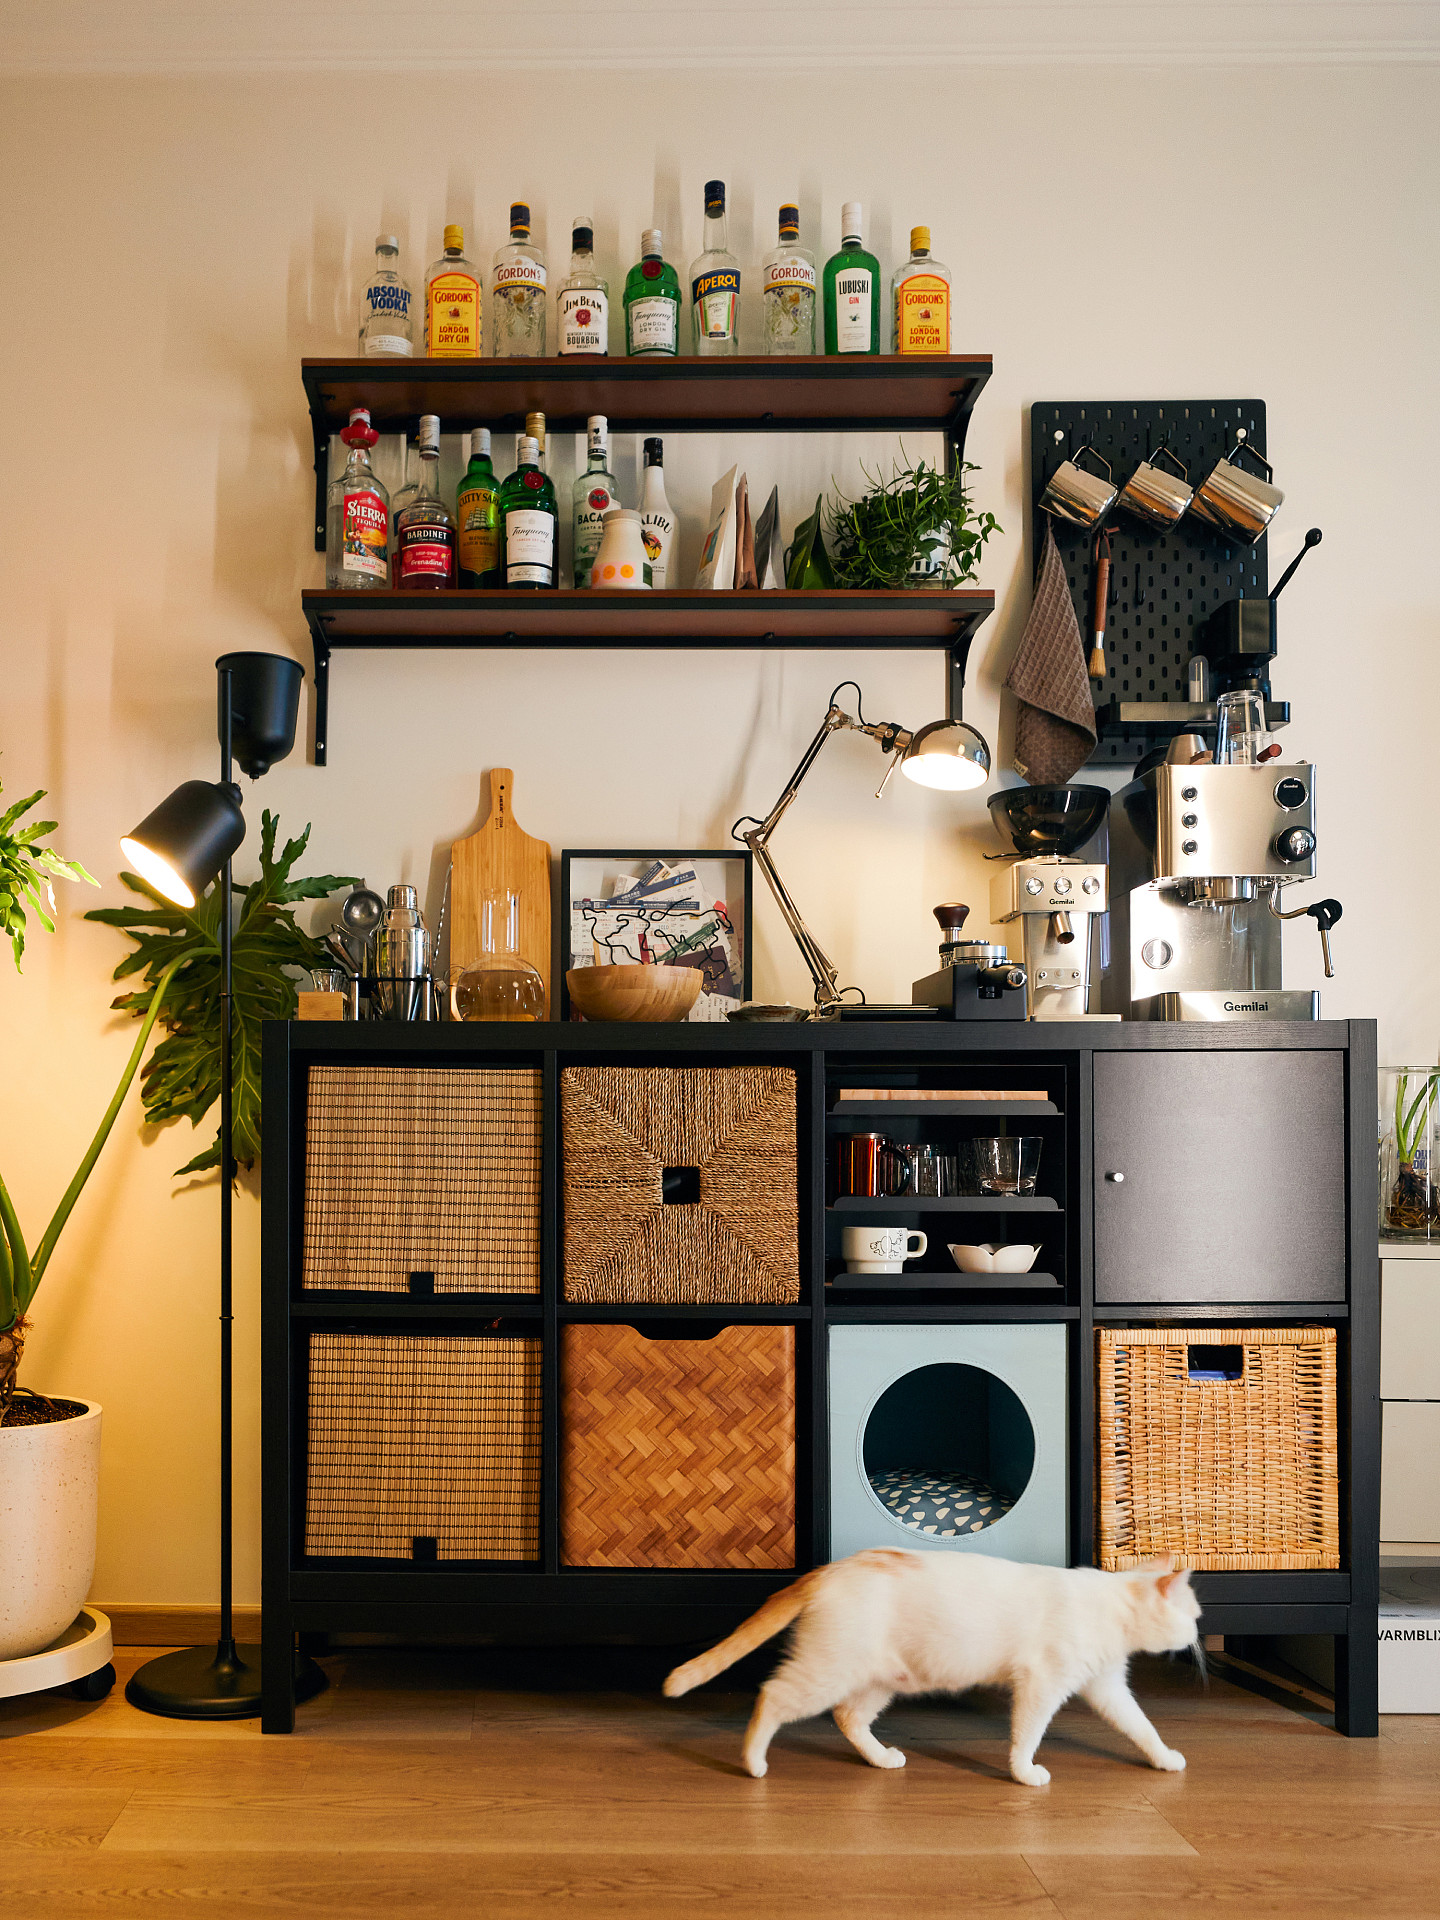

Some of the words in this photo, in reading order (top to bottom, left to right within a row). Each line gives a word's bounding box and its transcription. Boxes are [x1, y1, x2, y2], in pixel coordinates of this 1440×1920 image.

[497, 267, 541, 281] GORDON'S
[771, 267, 814, 281] GORDON'S
[696, 274, 738, 298] APEROL
[839, 280, 869, 295] LUBUSKI
[366, 286, 412, 304] ABSOLUT
[434, 291, 473, 304] GORDON'S
[849, 296, 860, 304] GIN
[905, 293, 944, 305] GORDON'S
[371, 297, 408, 314] VODKA
[563, 298, 579, 315] JIM
[580, 295, 602, 313] BEAM
[439, 325, 469, 333] LONDON
[438, 334, 455, 343] DRY
[455, 334, 470, 343] GIN
[566, 336, 600, 345] BOURBON
[909, 336, 926, 345] DRY
[926, 336, 941, 345] GIN
[459, 492, 482, 507] CUTTY
[347, 499, 386, 525] SIERRA
[356, 517, 381, 529] TEQUILA
[577, 512, 603, 525] BACA
[641, 514, 673, 534] ALIBU
[407, 529, 447, 540] BARDINET
[512, 526, 550, 538] Tanqueray
[410, 559, 443, 567] Grenadine
[1223, 1001, 1269, 1011] Gemilai
[1378, 1629, 1440, 1641] VARMBLI
